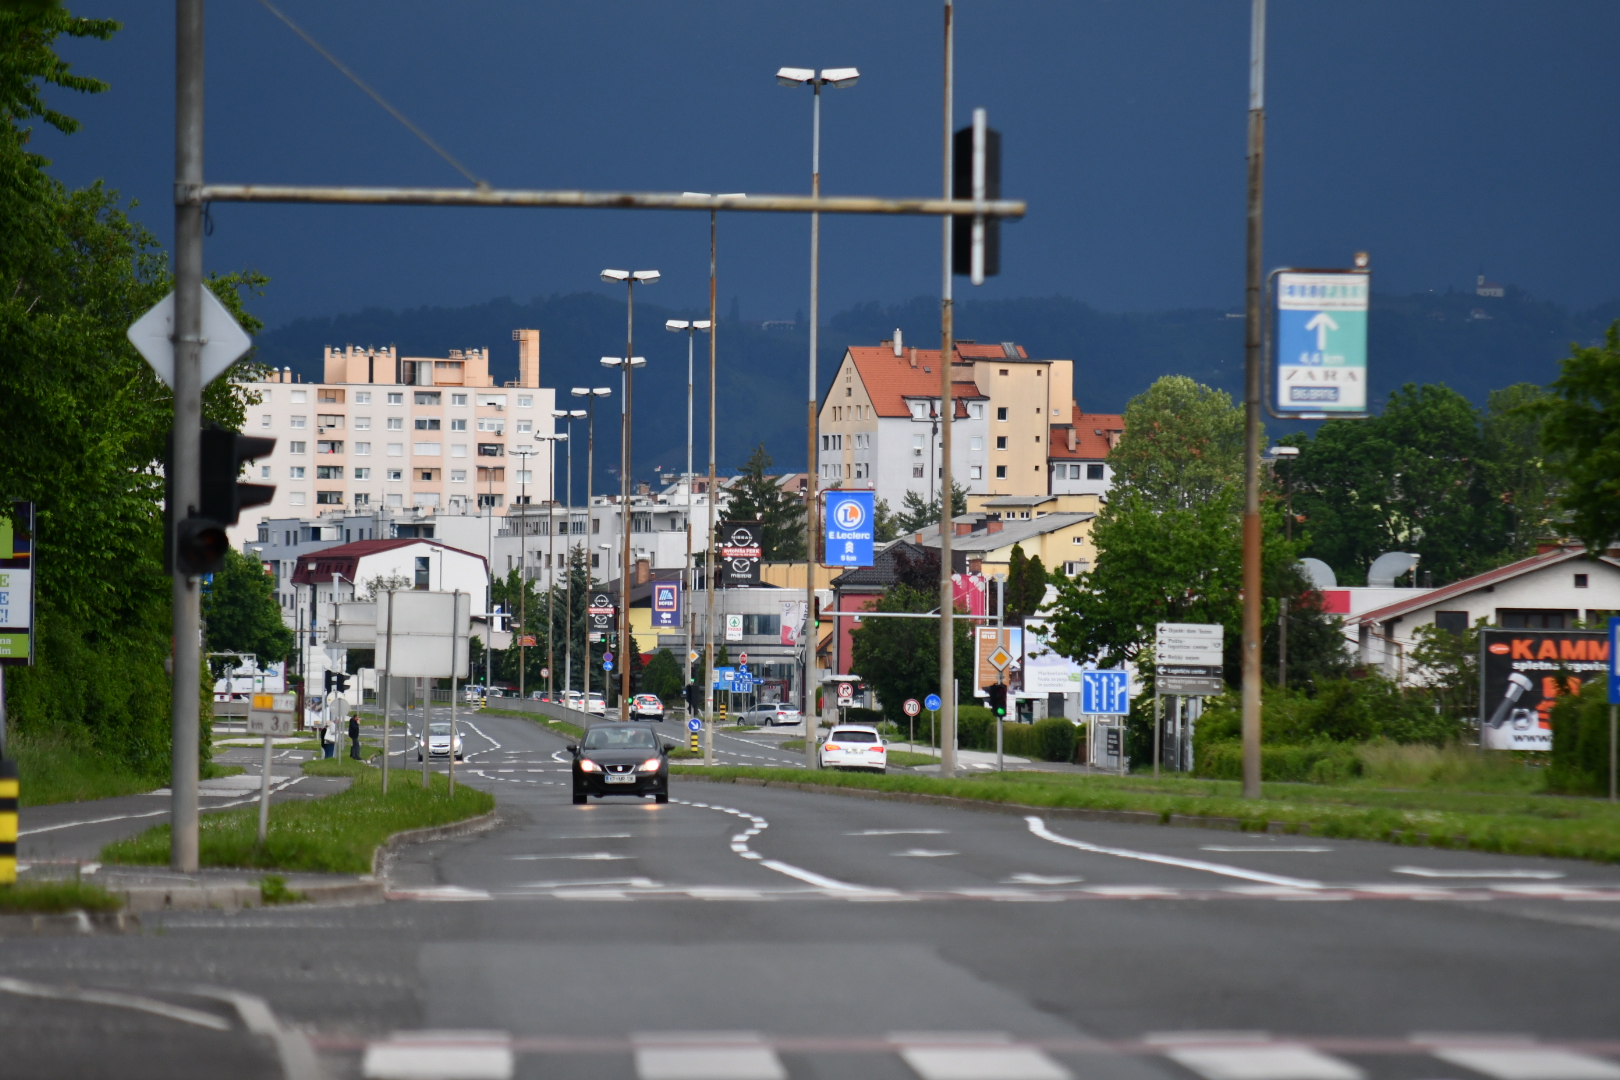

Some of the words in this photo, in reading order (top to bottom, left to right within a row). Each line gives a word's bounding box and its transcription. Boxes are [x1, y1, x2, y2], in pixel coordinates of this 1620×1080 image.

[1285, 369, 1359, 381] ZARA
[829, 531, 870, 540] E.Leclerc
[907, 703, 917, 712] 70
